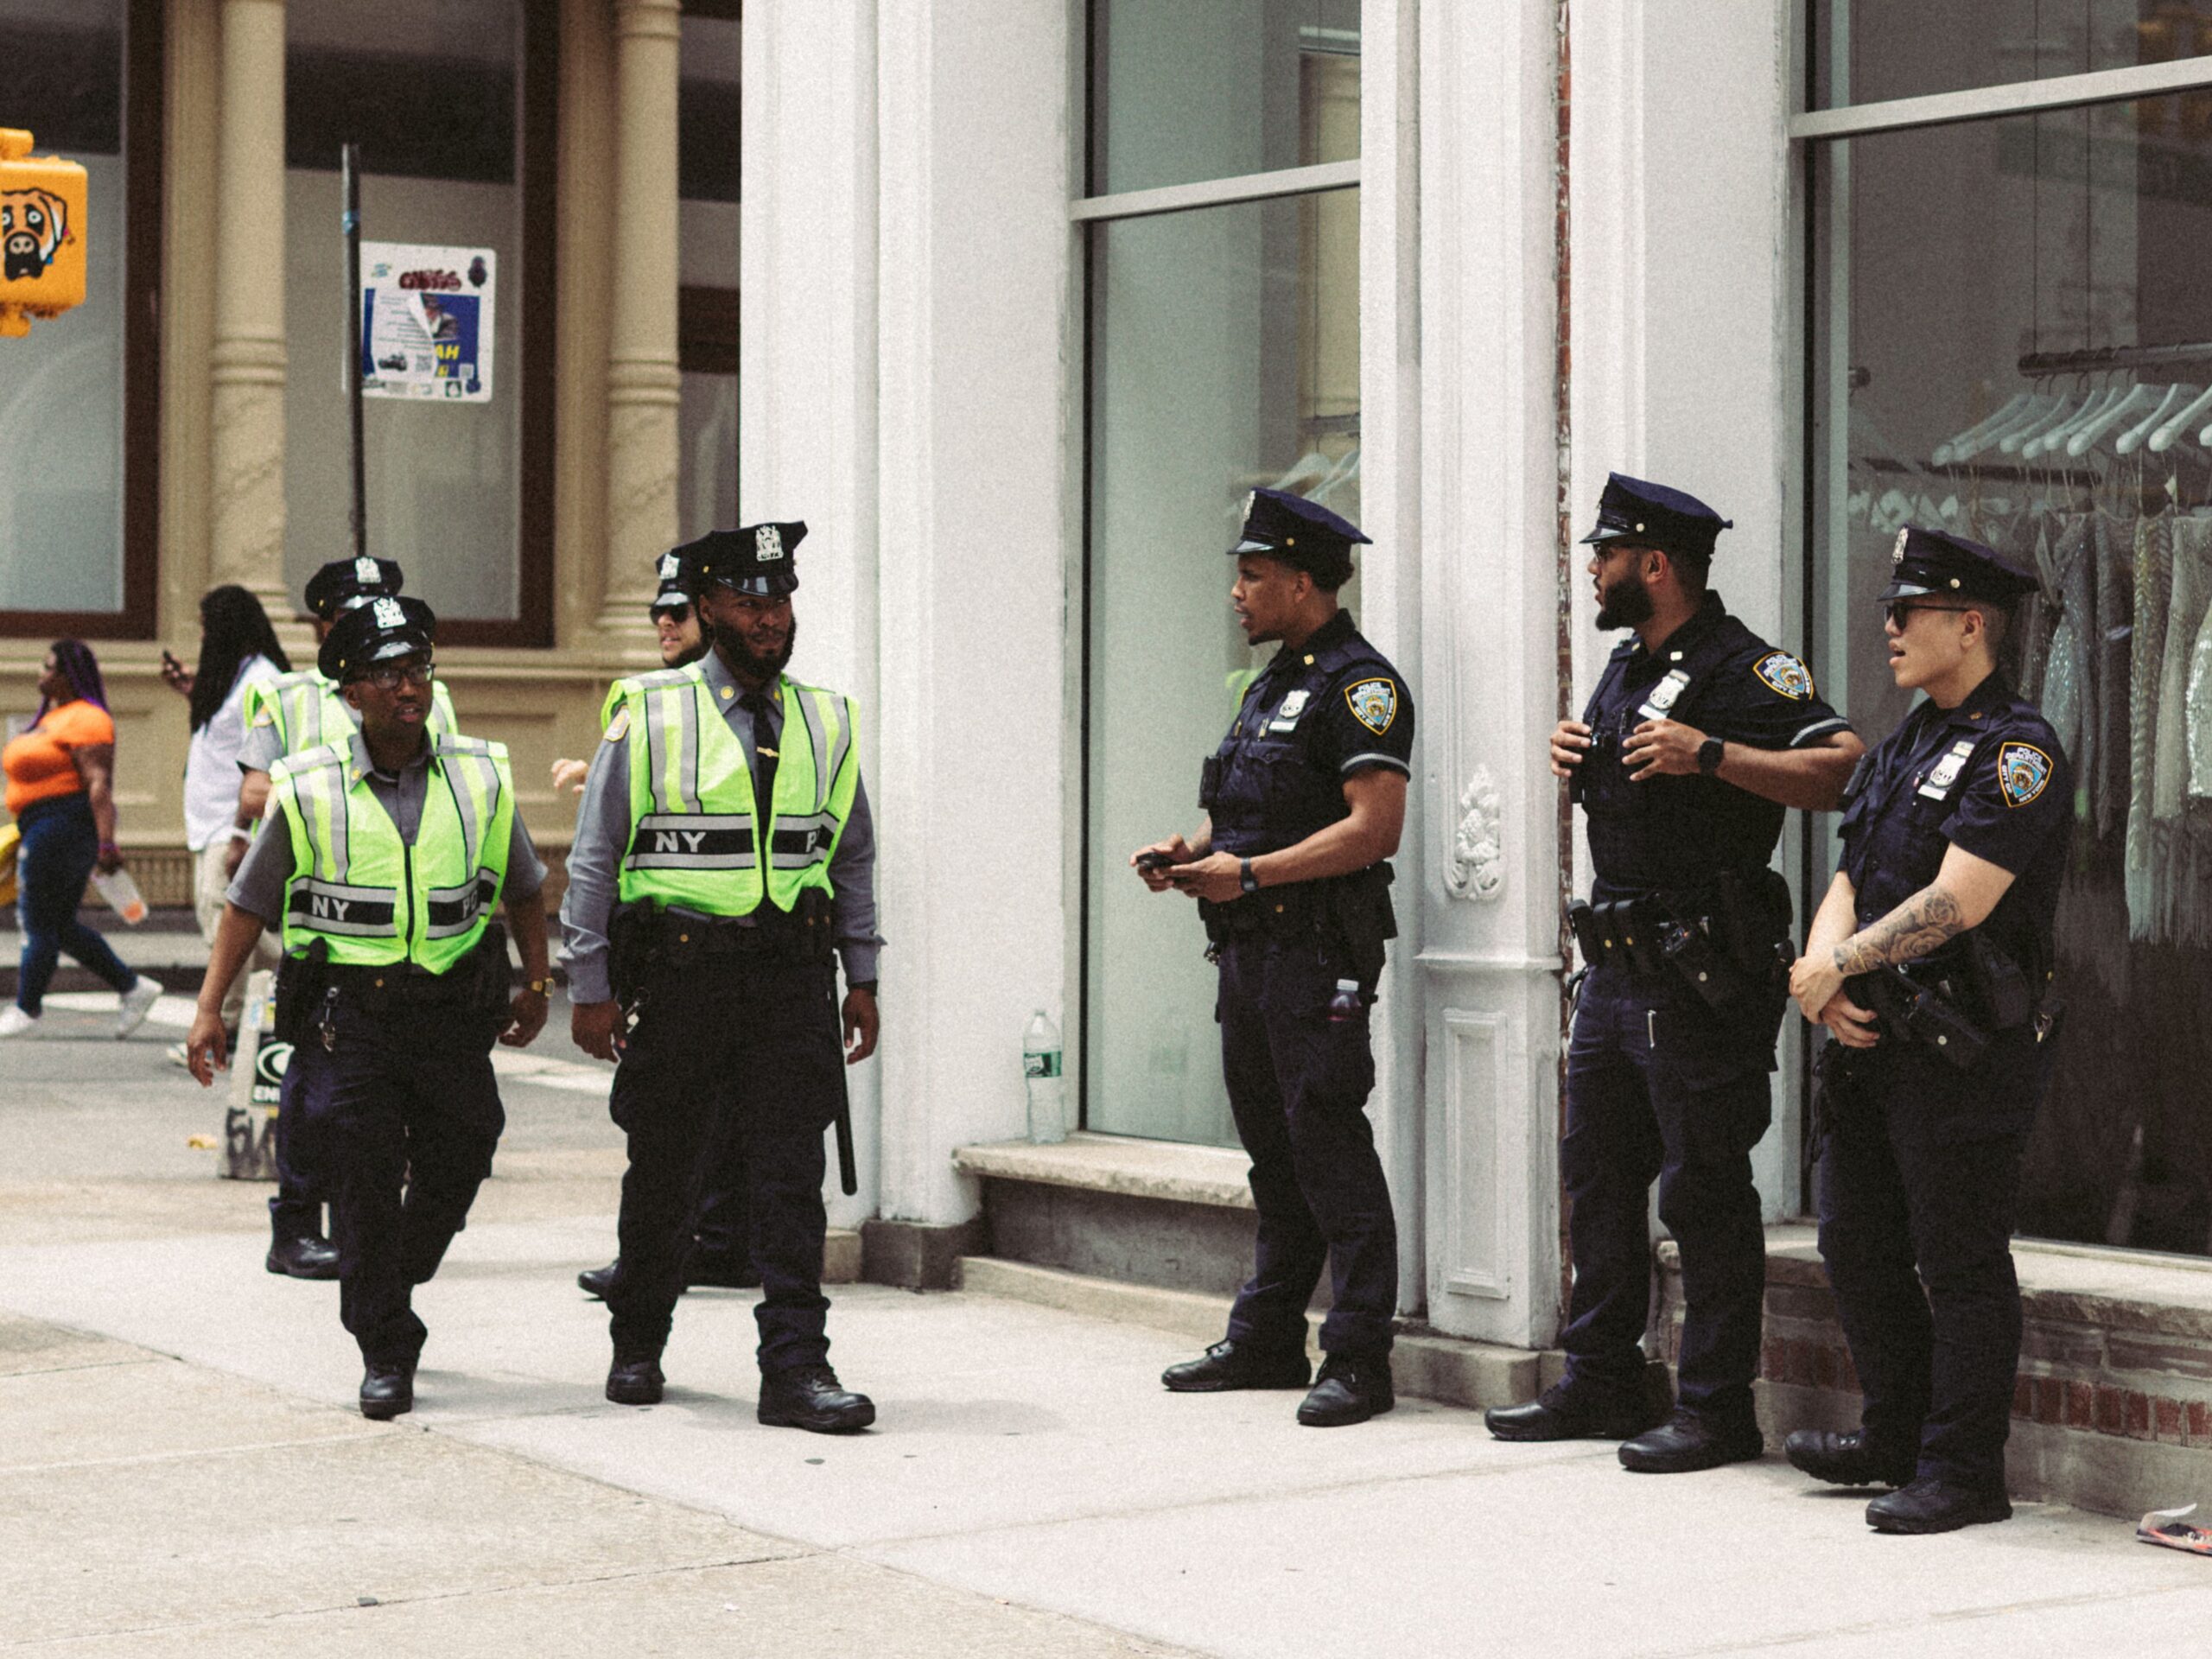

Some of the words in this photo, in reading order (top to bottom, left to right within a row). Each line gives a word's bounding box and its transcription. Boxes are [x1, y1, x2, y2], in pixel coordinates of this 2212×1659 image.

[2005, 752, 2047, 775] DEPARTMENT
[2017, 747, 2043, 763] POLICE
[2005, 783, 2012, 793] OF
[2018, 792, 2031, 803] NEW
[2031, 779, 2045, 794] YORK
[655, 831, 707, 853] NY
[312, 893, 349, 922] NY
